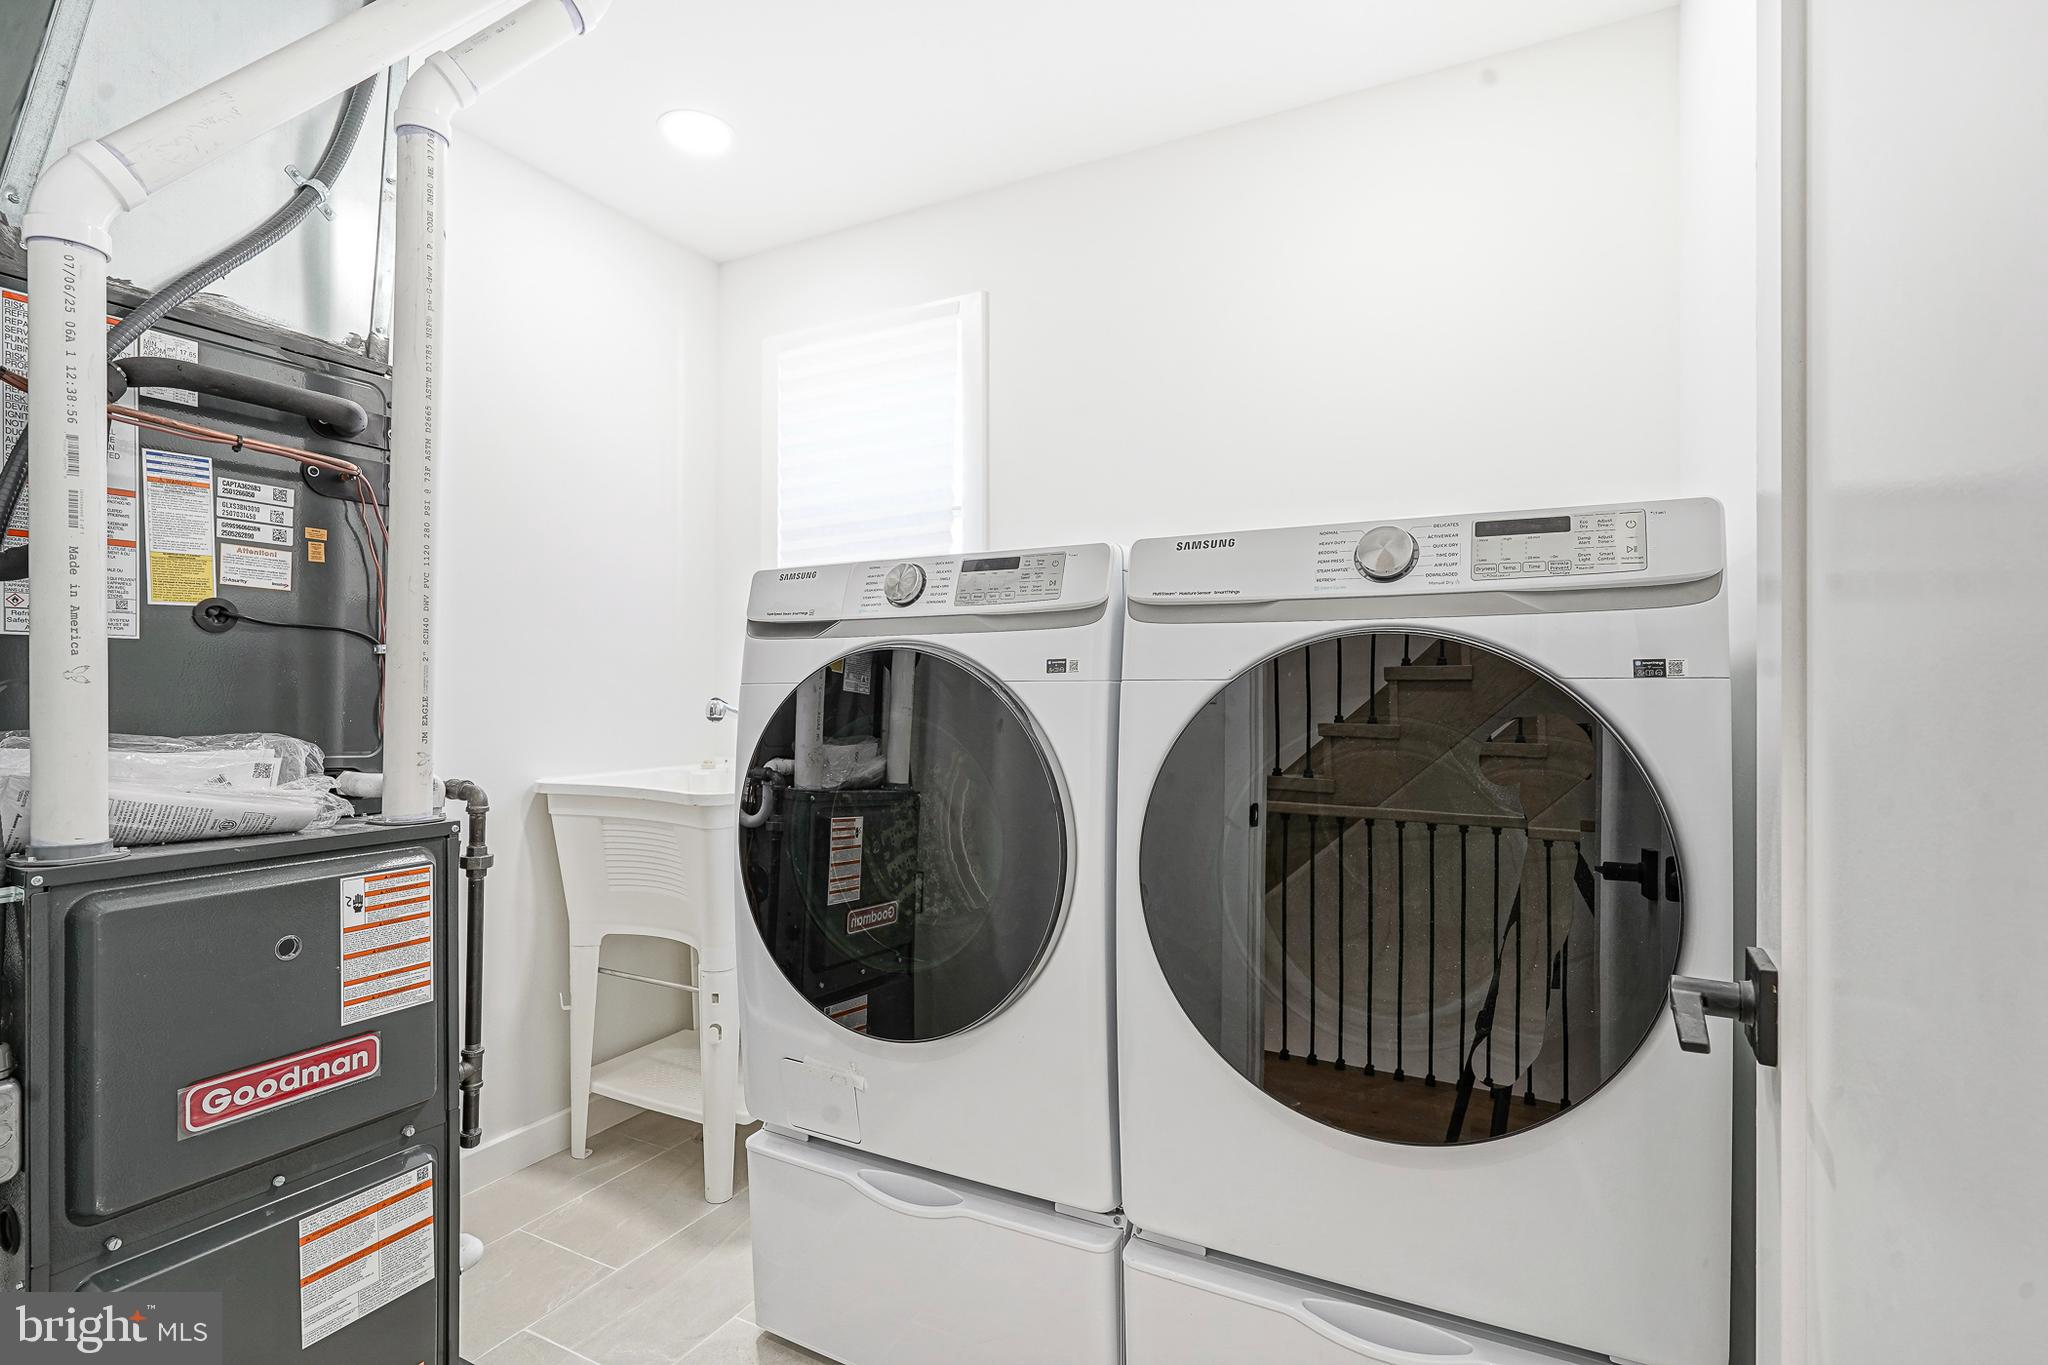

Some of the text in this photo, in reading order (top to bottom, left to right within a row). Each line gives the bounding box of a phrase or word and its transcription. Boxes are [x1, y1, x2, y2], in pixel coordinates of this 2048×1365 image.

[427, 183, 435, 206] JM90
[426, 211, 434, 234] CODE
[62, 254, 77, 313] 07/06/25
[4, 299, 25, 311] RISK
[65, 321, 77, 343] 06A
[143, 337, 157, 347] MIN
[143, 345, 167, 354] ROOM
[5, 350, 26, 361] RISK
[5, 392, 27, 403] RISK
[65, 364, 78, 424] 12:38:56
[5, 418, 24, 428] NOT
[1176, 538, 1236, 551] SAMSUNG
[779, 571, 817, 581] SAMSUNG
[68, 545, 81, 656] Made in America
[421, 696, 429, 726] EAGLE
[201, 1050, 369, 1115] Goodman
